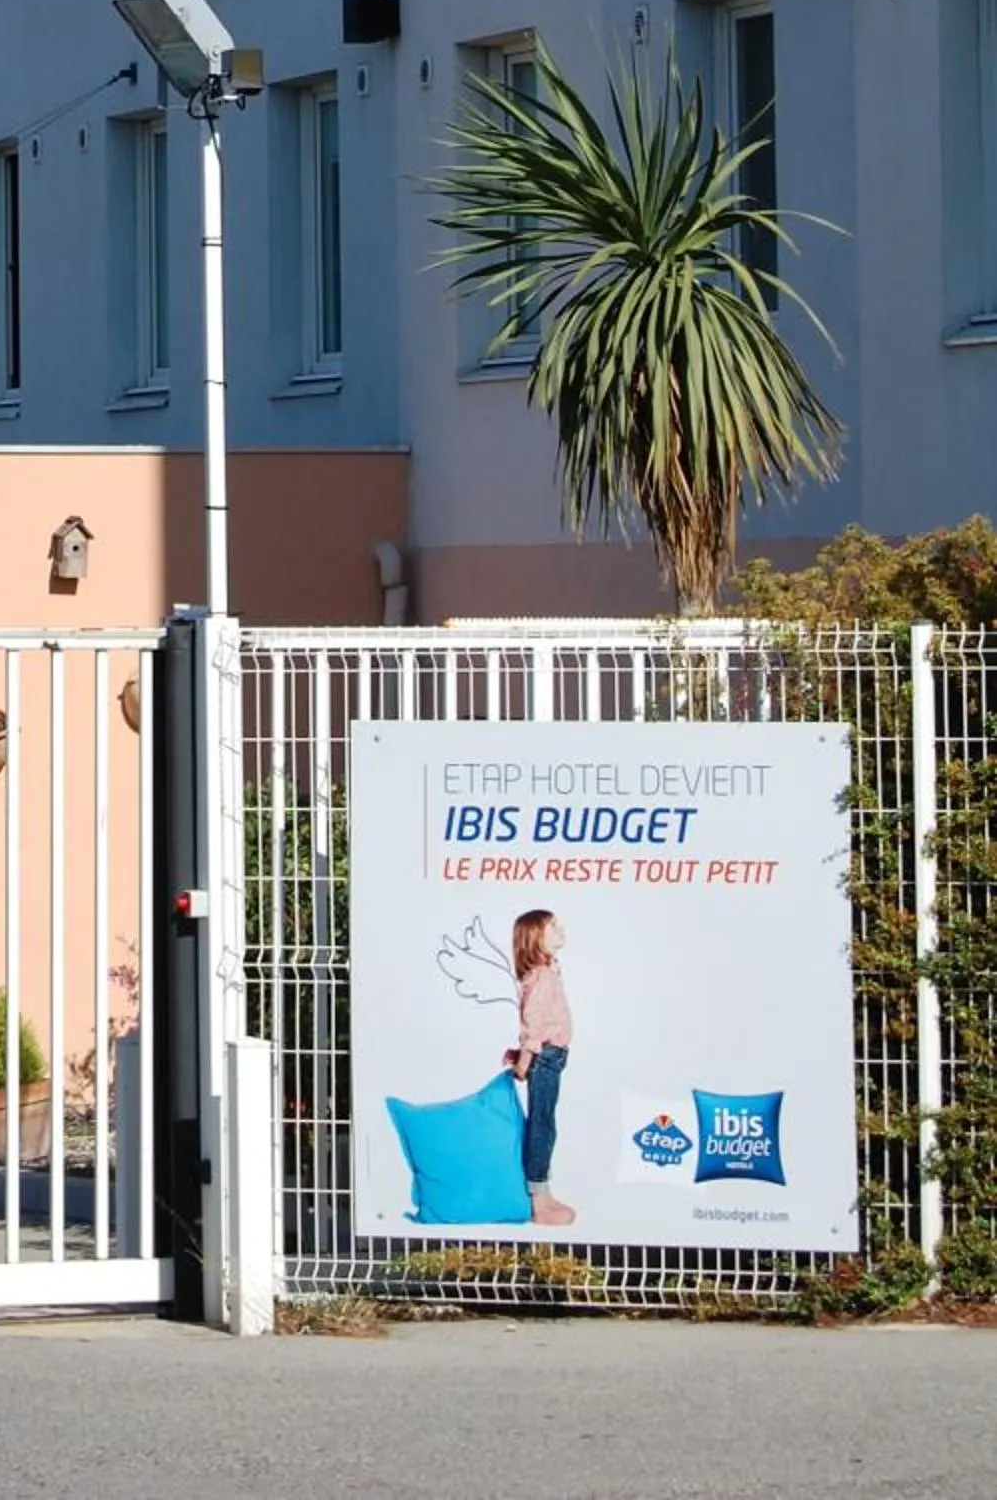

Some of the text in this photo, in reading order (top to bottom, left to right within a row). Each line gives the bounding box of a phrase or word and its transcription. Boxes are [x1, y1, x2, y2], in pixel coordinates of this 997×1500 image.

[443, 763, 773, 798] ETAP HOTEL DEVIENT
[443, 806, 698, 844] IBIS BUDGET
[443, 857, 779, 885] LE PRIX RESTE TOUT PETIT
[714, 1108, 764, 1137] ibis
[640, 1131, 687, 1152] Etap
[706, 1135, 773, 1161] budget
[692, 1207, 790, 1224] ibisbudget.com
